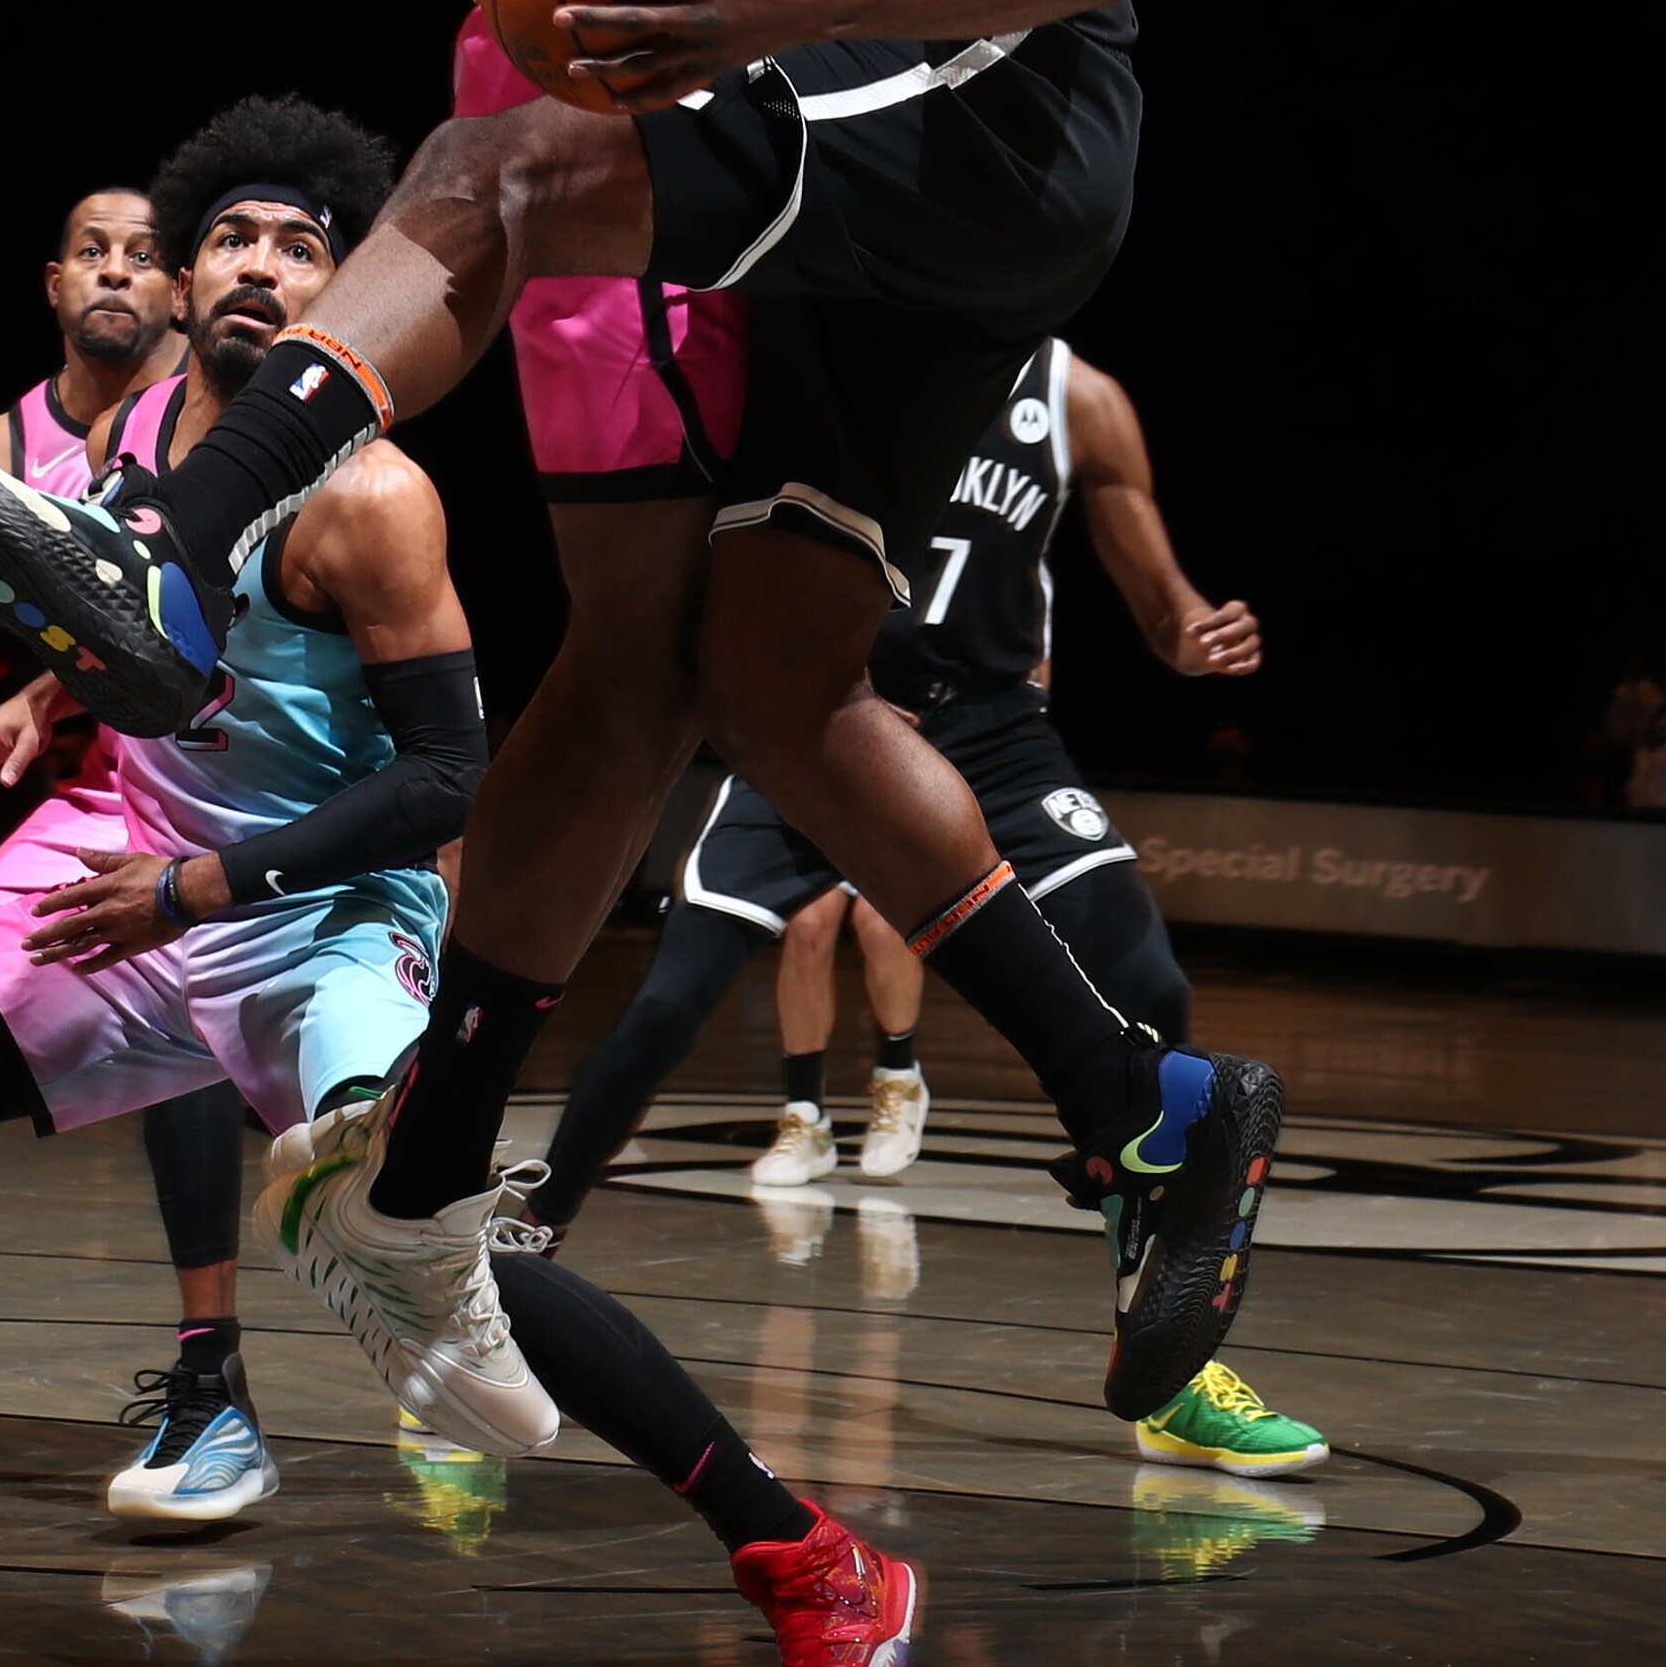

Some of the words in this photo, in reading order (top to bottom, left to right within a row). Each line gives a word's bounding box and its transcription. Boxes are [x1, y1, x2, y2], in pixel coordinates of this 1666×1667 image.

[949, 455, 1049, 532] KLYN
[924, 535, 972, 625] 7
[1138, 836, 1303, 884] Special
[1310, 847, 1495, 903] Surgery
